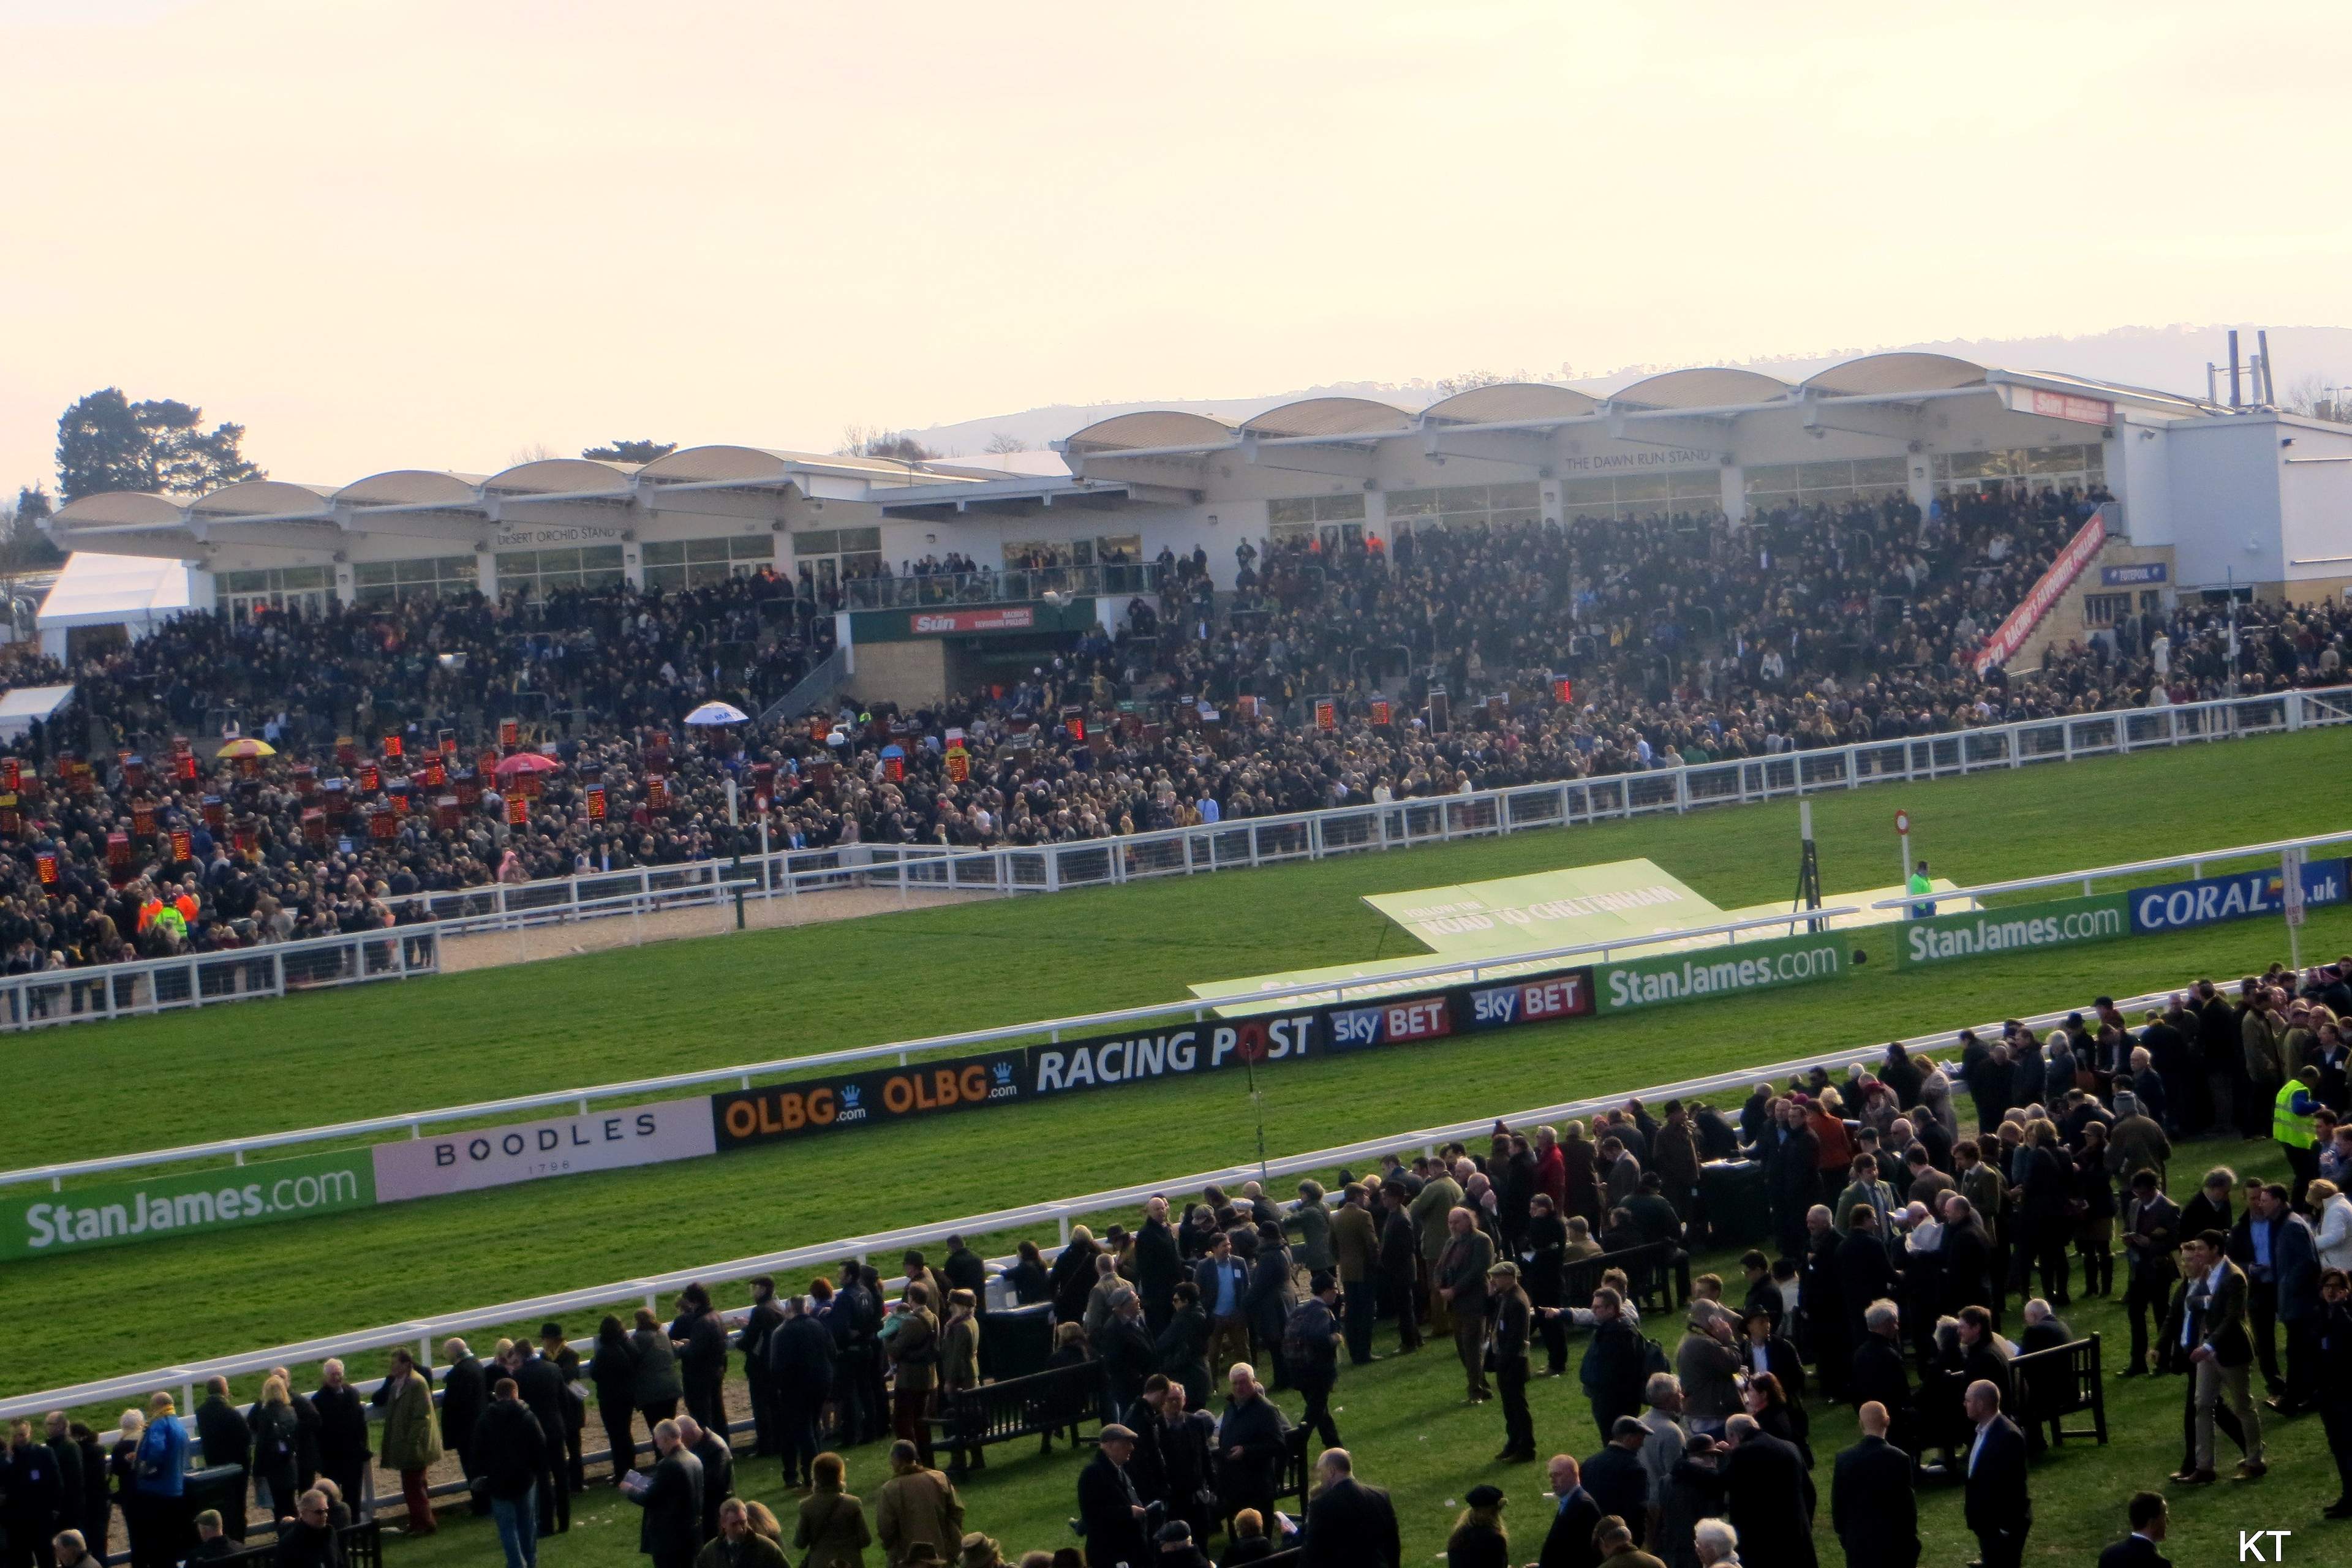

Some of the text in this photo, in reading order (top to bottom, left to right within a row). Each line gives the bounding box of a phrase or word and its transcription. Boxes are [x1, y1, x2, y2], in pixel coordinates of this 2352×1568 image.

[1566, 450, 1711, 469] THE DAWN RUN STAND
[497, 526, 615, 545] DESERT ORCHID STAND
[916, 616, 956, 632] Sun
[1403, 901, 1484, 918] FOLLOW THE
[1419, 886, 1683, 936] ROAD TO CHELTENHAM
[1909, 908, 2119, 961] StanJames.com
[1609, 946, 1838, 1008] StanJames.com
[1333, 1003, 1442, 1044] sky BET
[1474, 981, 1578, 1022] sky BET
[1037, 1016, 1313, 1091] RACING POST
[435, 1113, 657, 1166] BOODLES
[26, 1169, 357, 1248] StanJames.com
